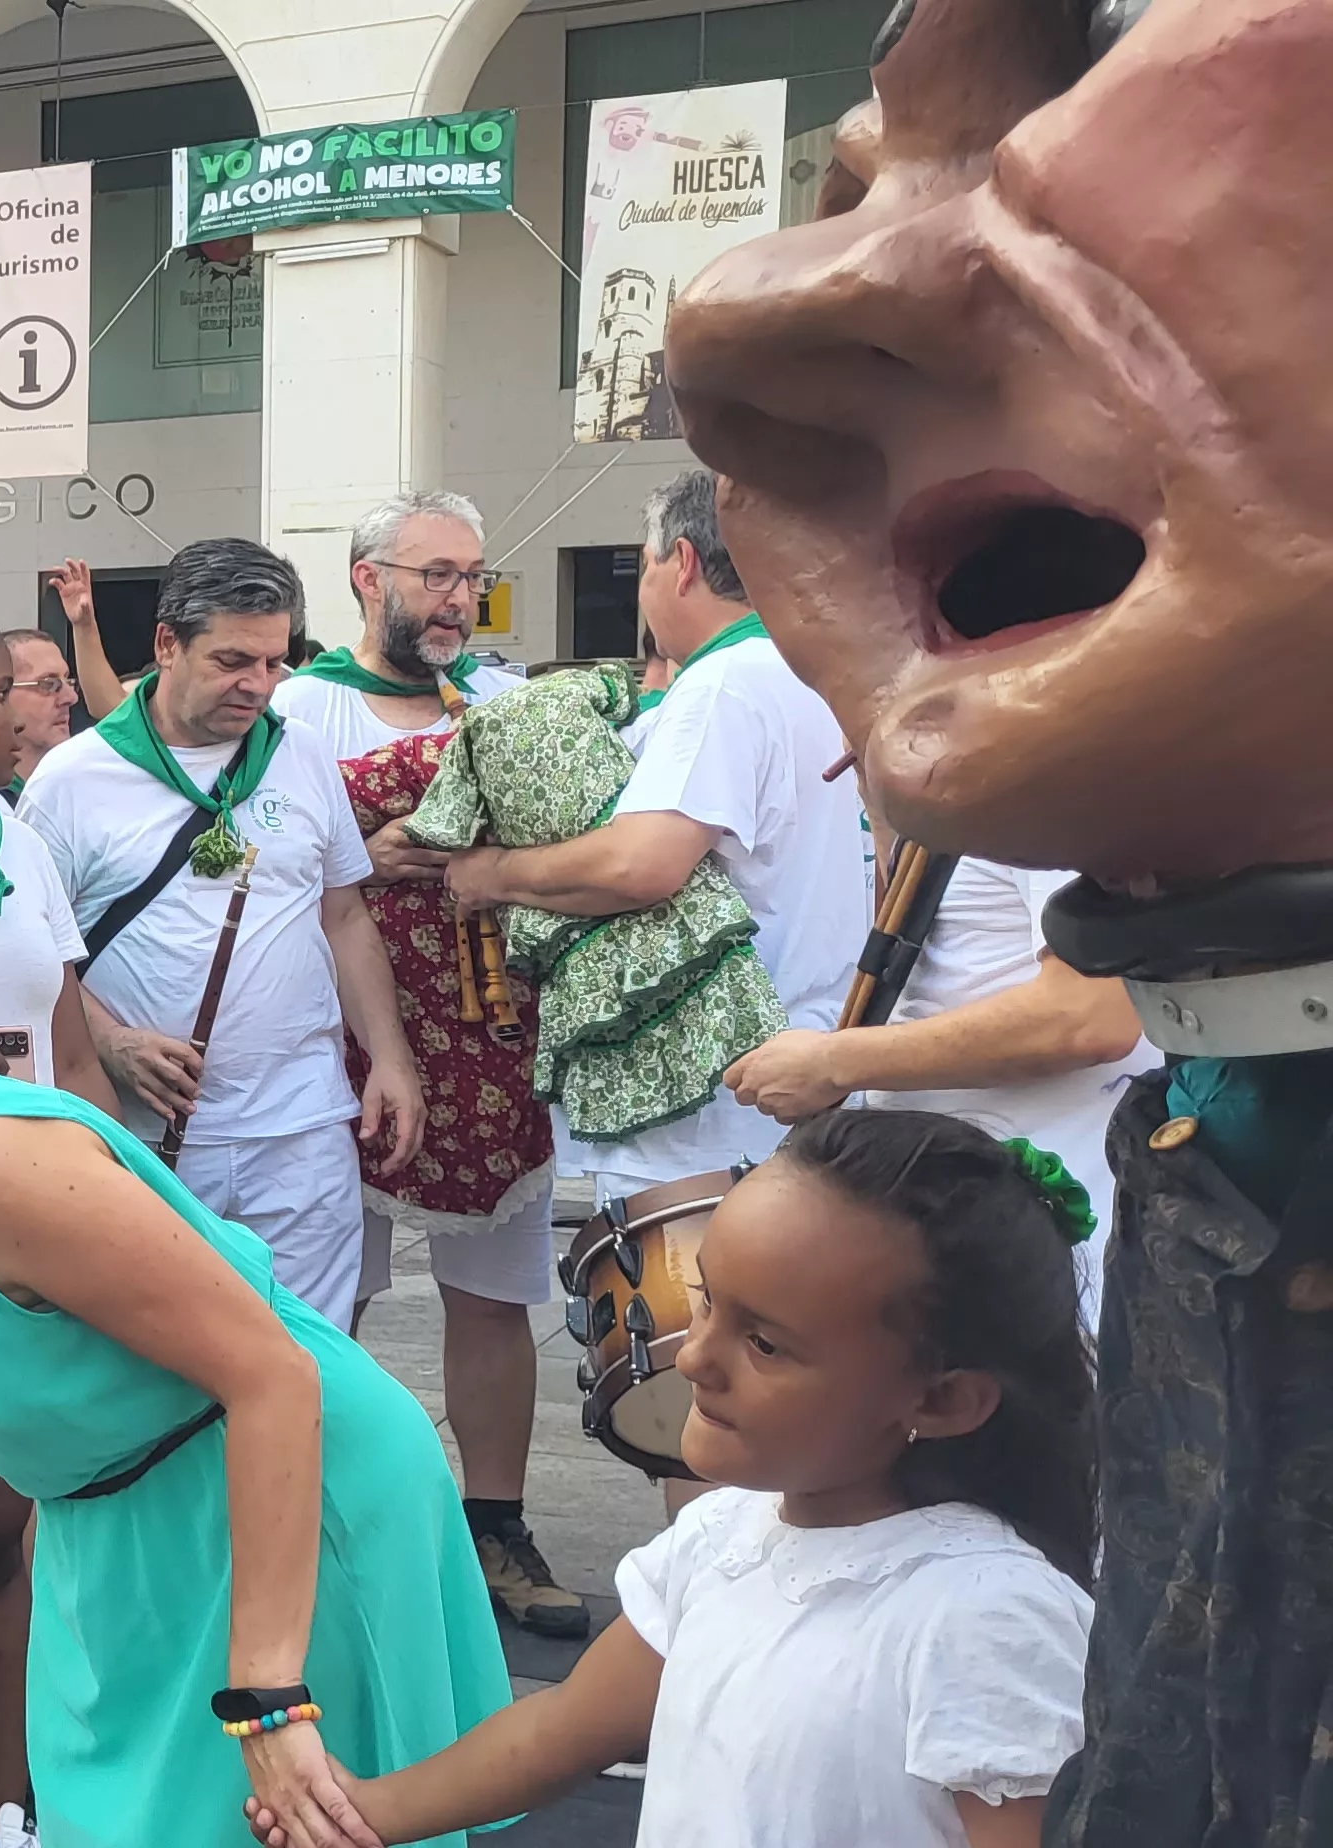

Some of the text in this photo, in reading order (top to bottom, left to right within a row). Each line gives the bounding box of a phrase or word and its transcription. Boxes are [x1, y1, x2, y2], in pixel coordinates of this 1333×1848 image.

[200, 121, 503, 184] YO NO FACILITO
[200, 161, 502, 217] ALCOHOL A MENORES
[673, 155, 766, 195] HUESCA
[618, 194, 769, 231] Ciudad de leyendas
[50, 223, 80, 245] de
